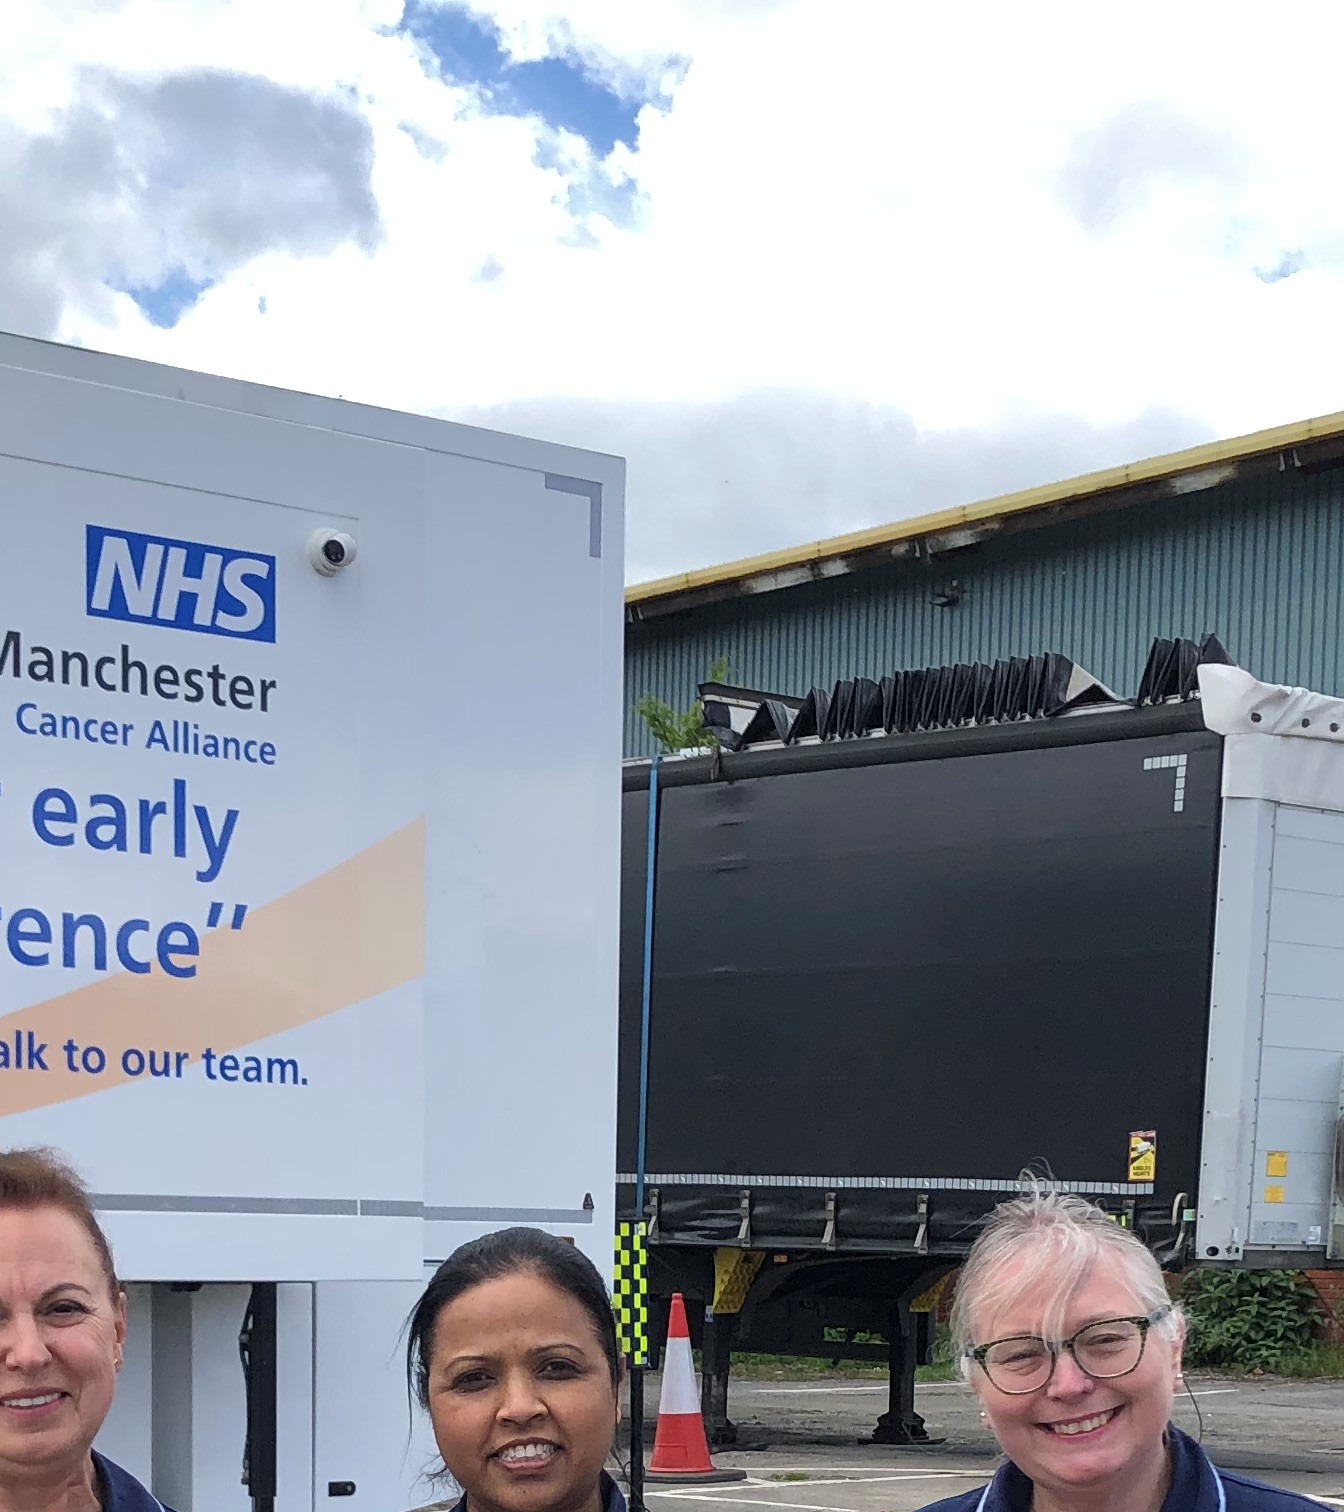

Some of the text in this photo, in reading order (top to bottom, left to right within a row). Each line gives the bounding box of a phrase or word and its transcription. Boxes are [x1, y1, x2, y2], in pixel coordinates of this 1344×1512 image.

[90, 535, 269, 632] NHS
[16, 702, 277, 766] Cancer Alliance
[31, 779, 239, 883] early
[63, 1038, 106, 1075] to
[121, 1051, 190, 1080] our
[202, 1047, 309, 1086] team.
